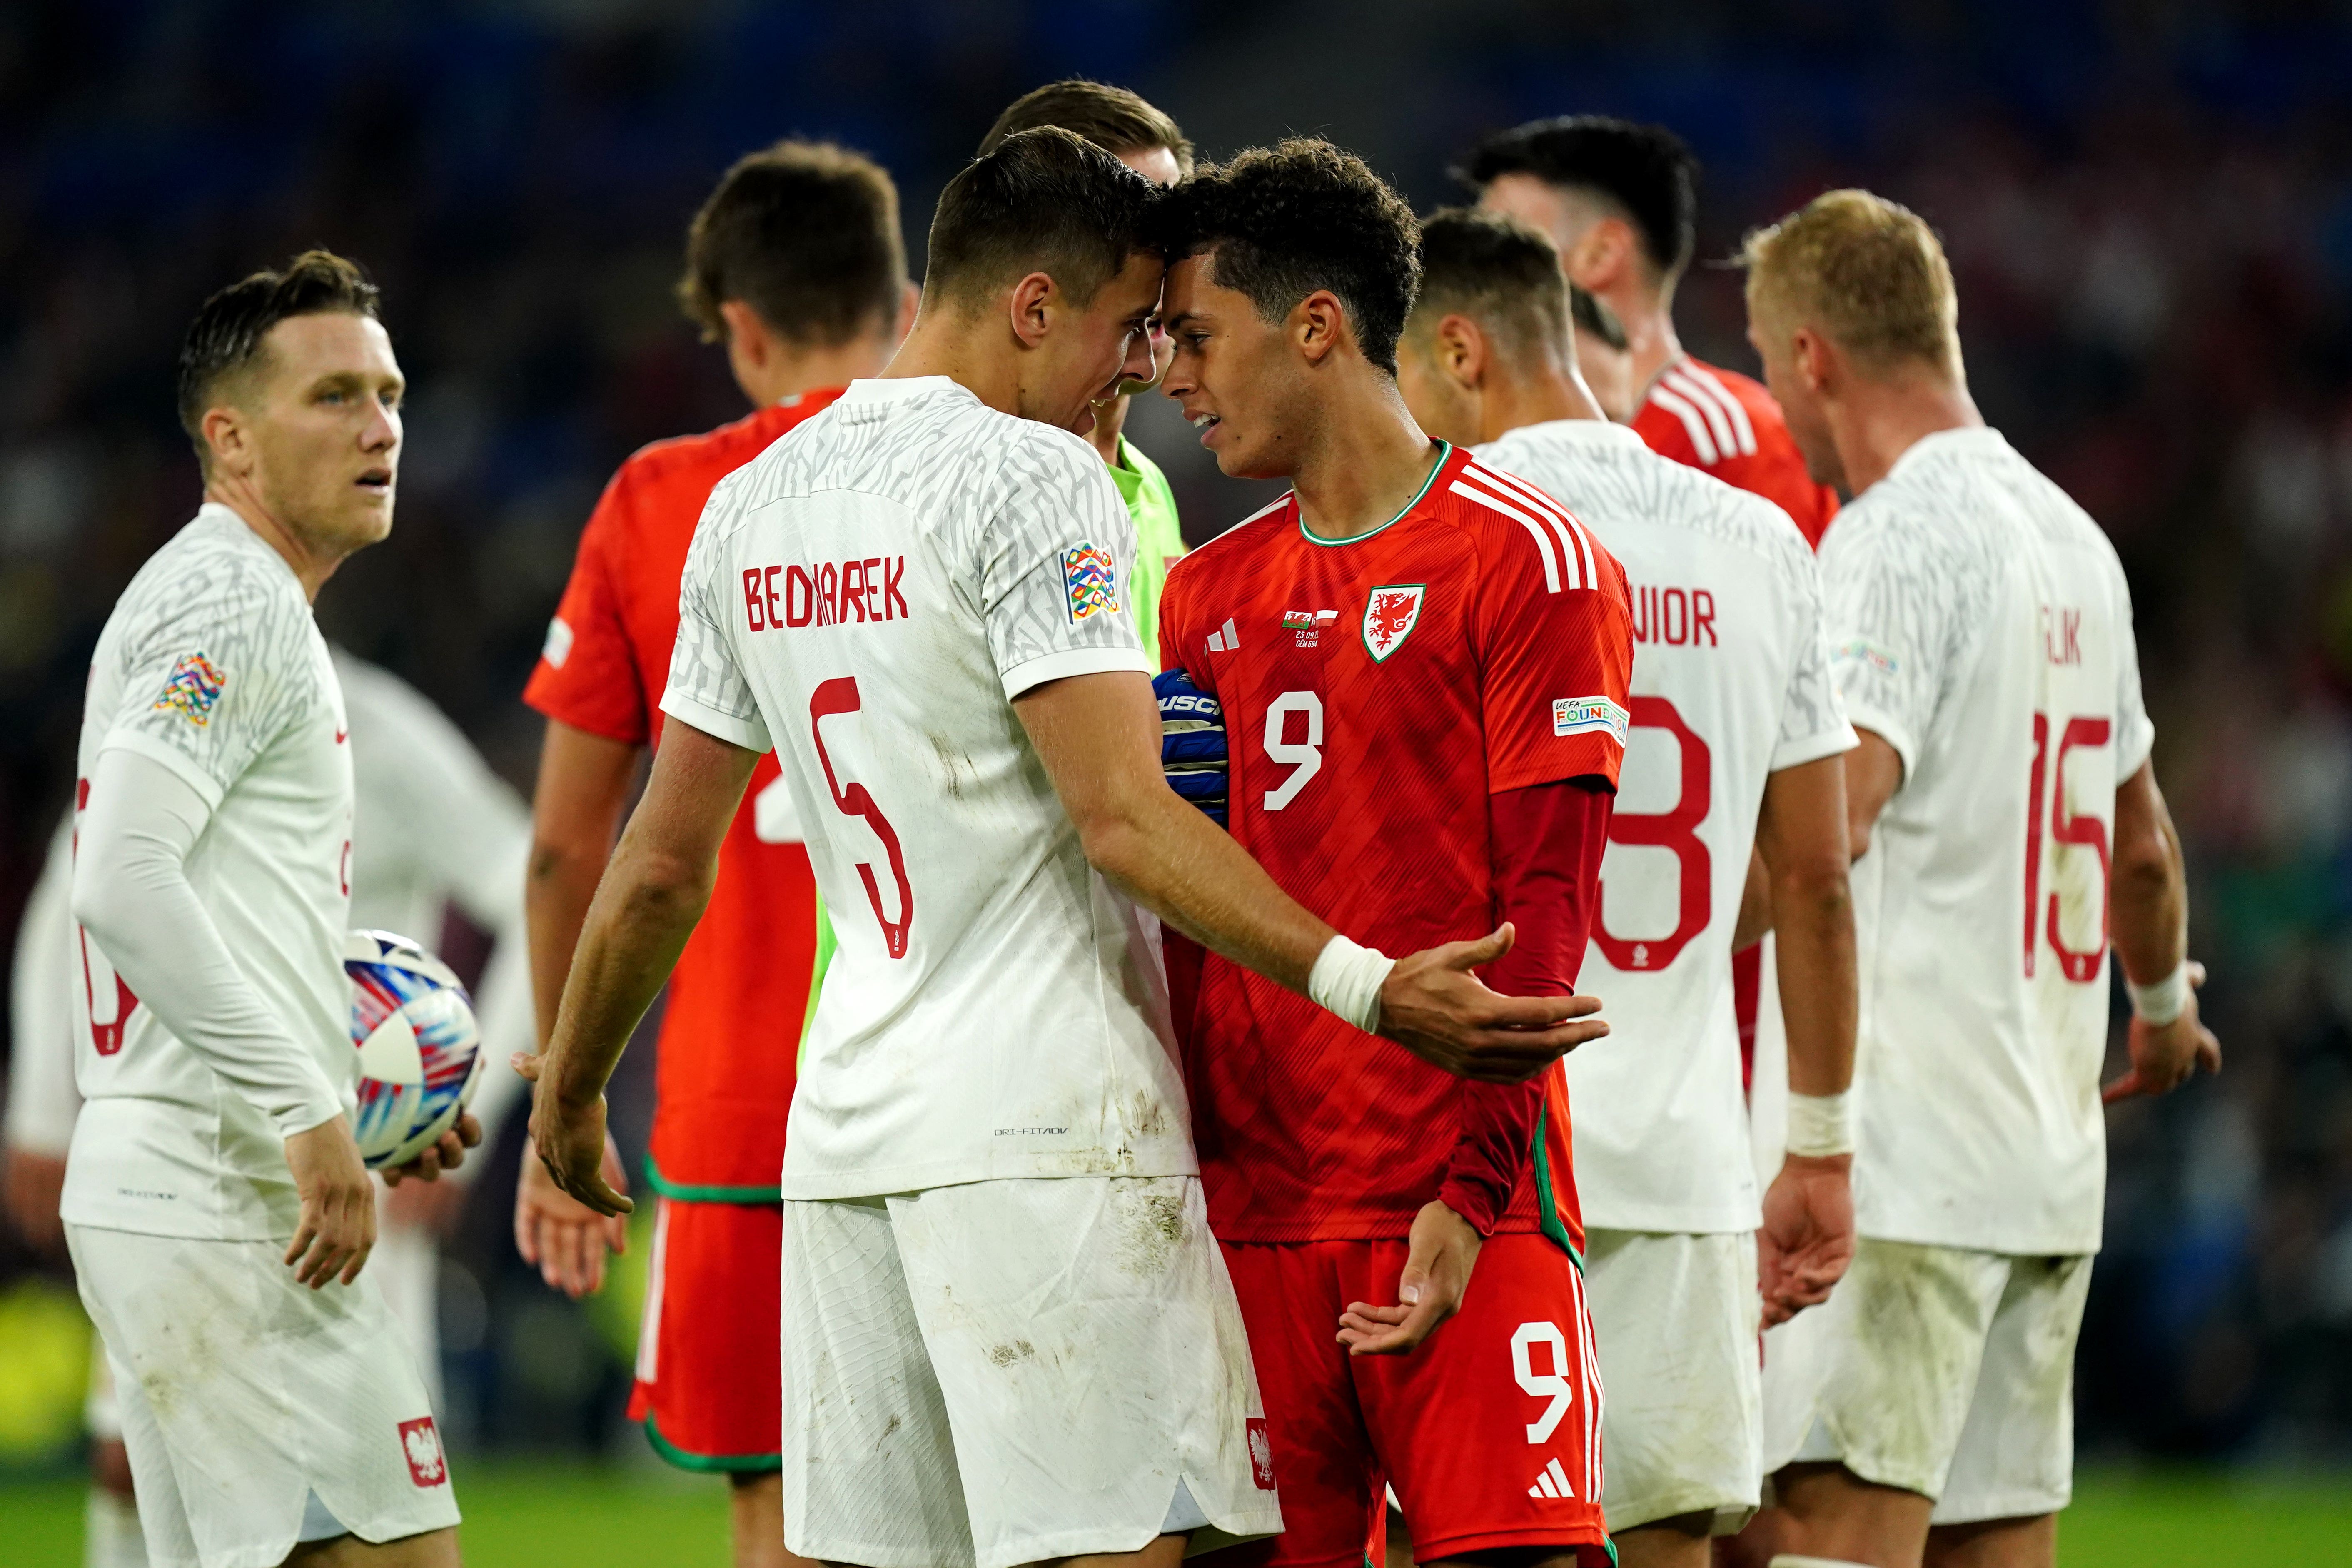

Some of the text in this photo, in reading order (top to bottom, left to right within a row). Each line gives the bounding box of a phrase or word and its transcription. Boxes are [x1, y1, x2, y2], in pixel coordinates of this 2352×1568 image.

[1157, 696, 1220, 715] USC
[1263, 691, 1323, 810] 9
[1556, 700, 1580, 710] UEFA
[1557, 707, 1627, 736] FOUNDATION
[809, 676, 913, 959] 5
[1589, 696, 1711, 972] 3
[2024, 710, 2111, 984] 15
[1510, 1321, 1573, 1444] 9
